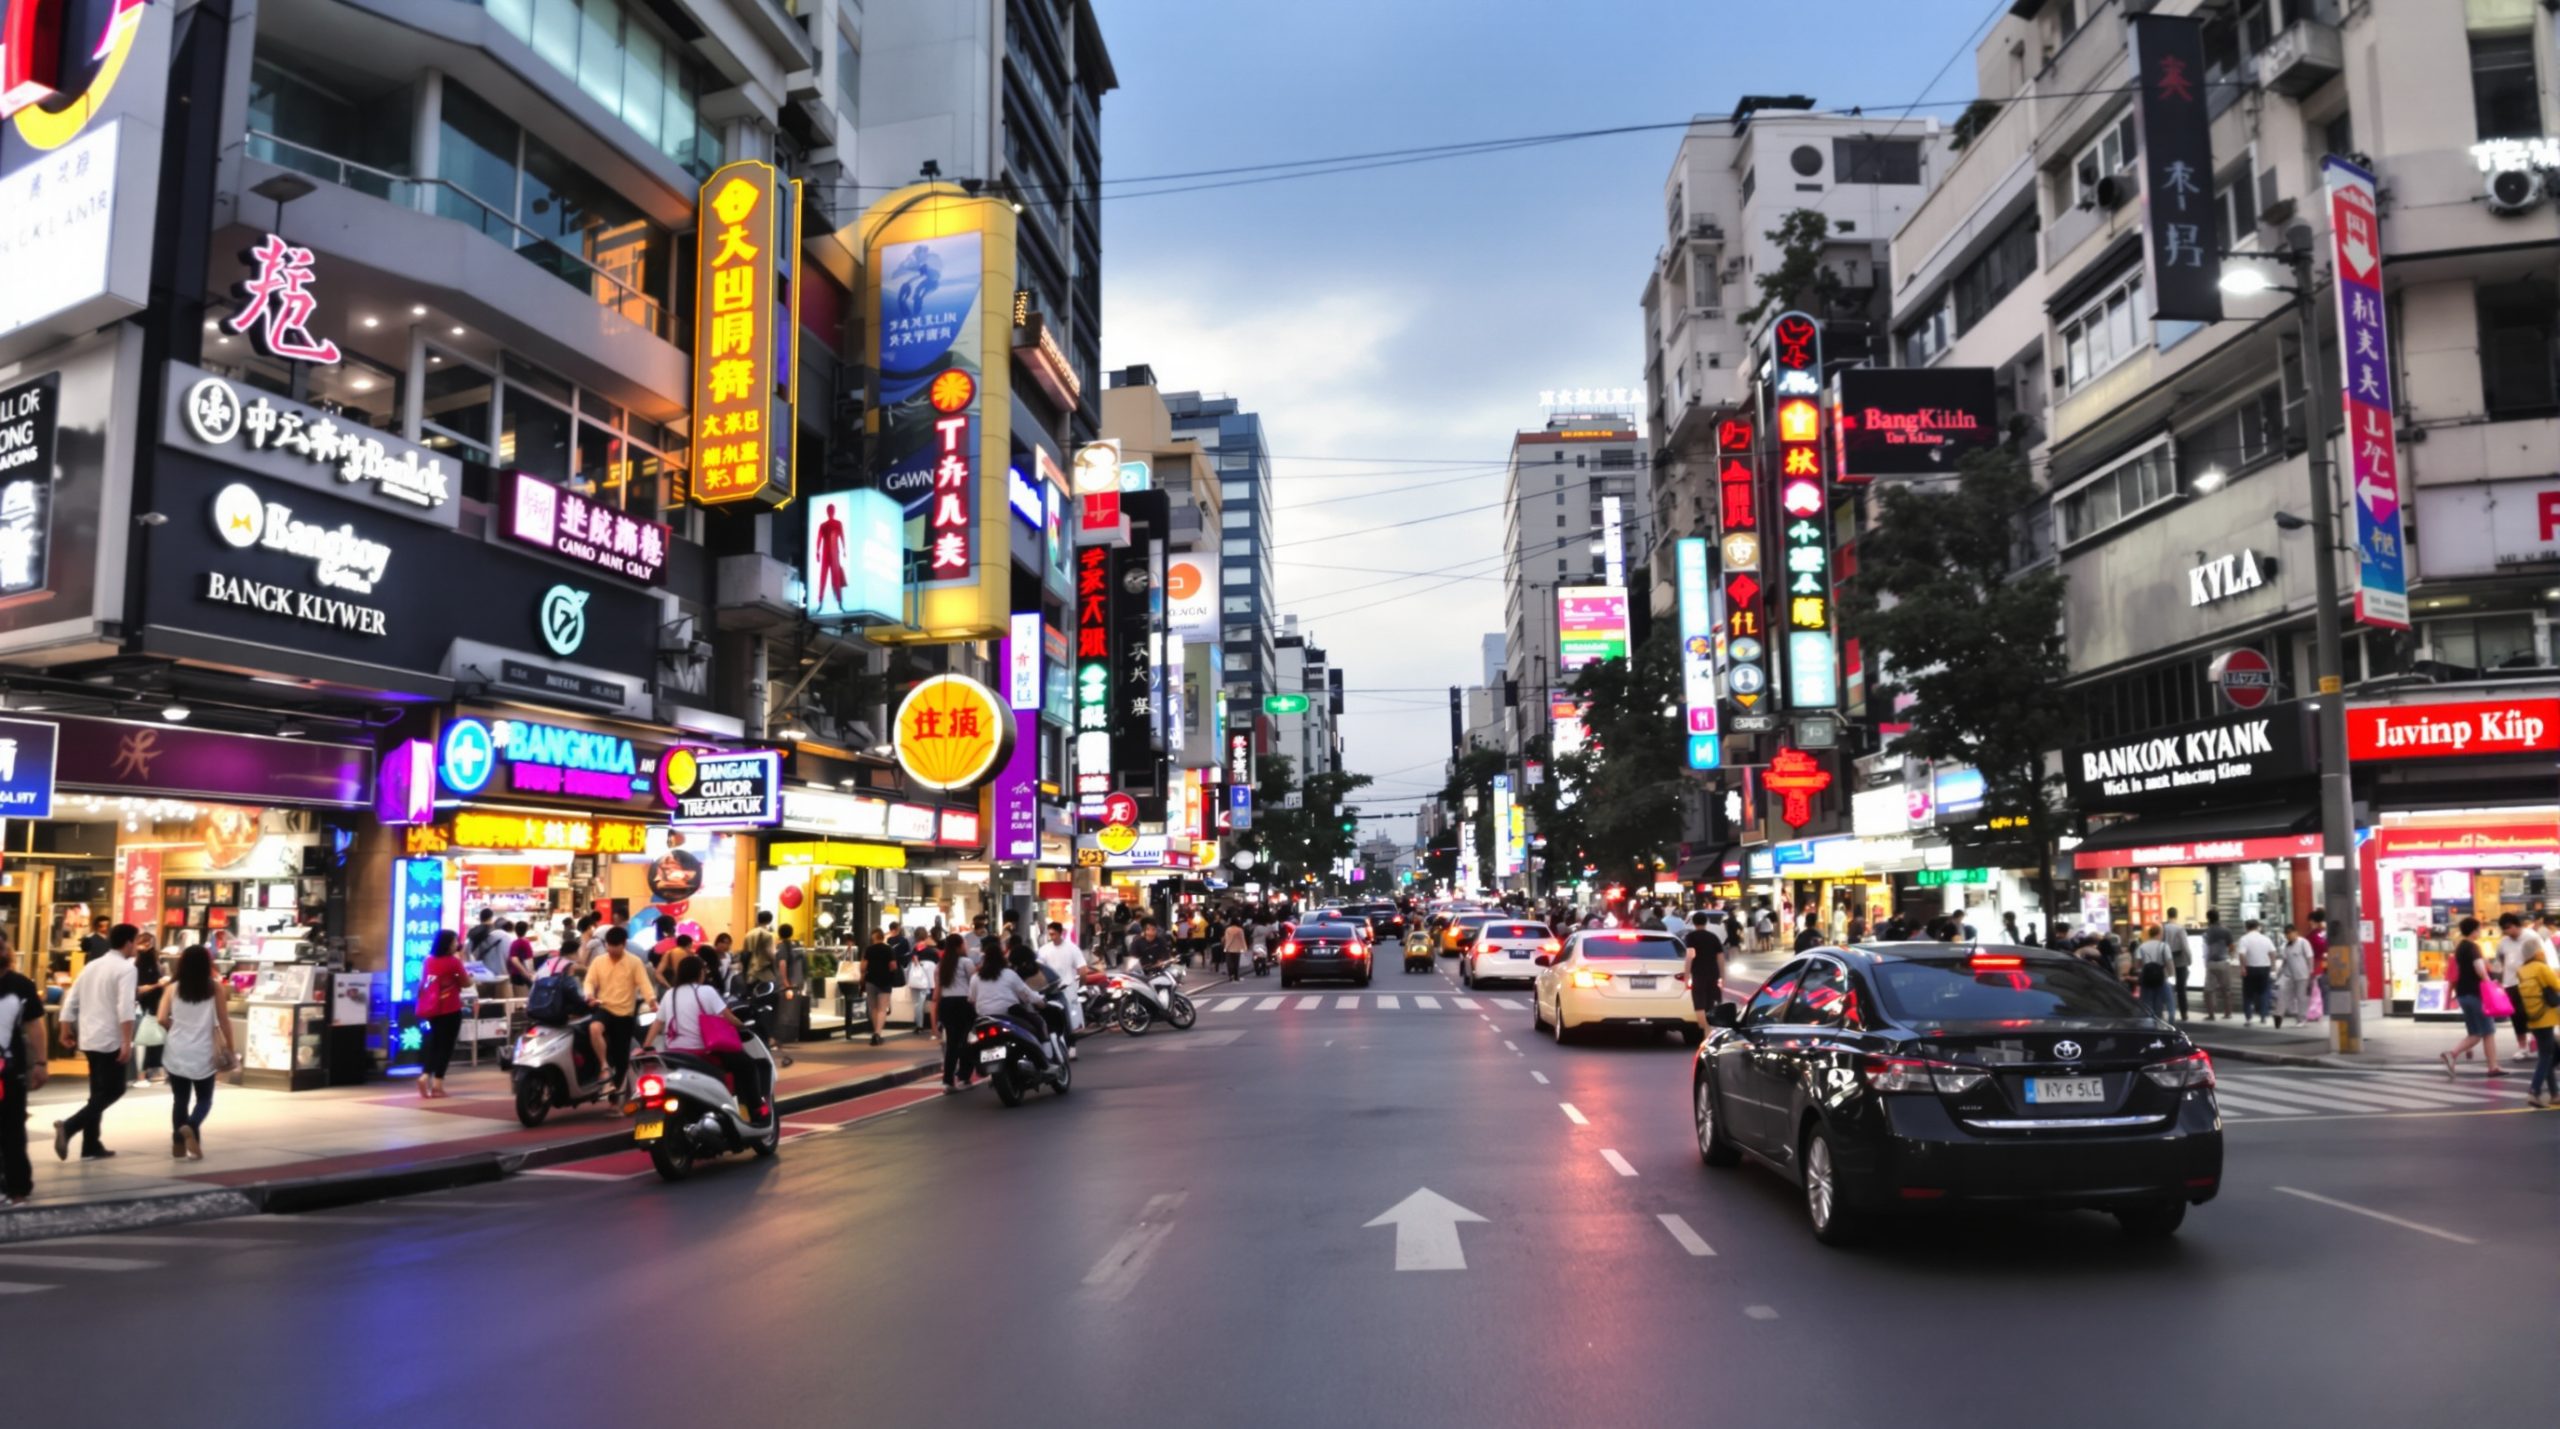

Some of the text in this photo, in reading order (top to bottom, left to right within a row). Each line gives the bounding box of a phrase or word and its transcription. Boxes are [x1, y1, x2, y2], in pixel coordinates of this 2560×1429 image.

[206, 571, 293, 616] BANGK
[297, 591, 387, 636] KLYWER
[2188, 547, 2262, 606] KYLA
[2185, 719, 2273, 764] KYANK
